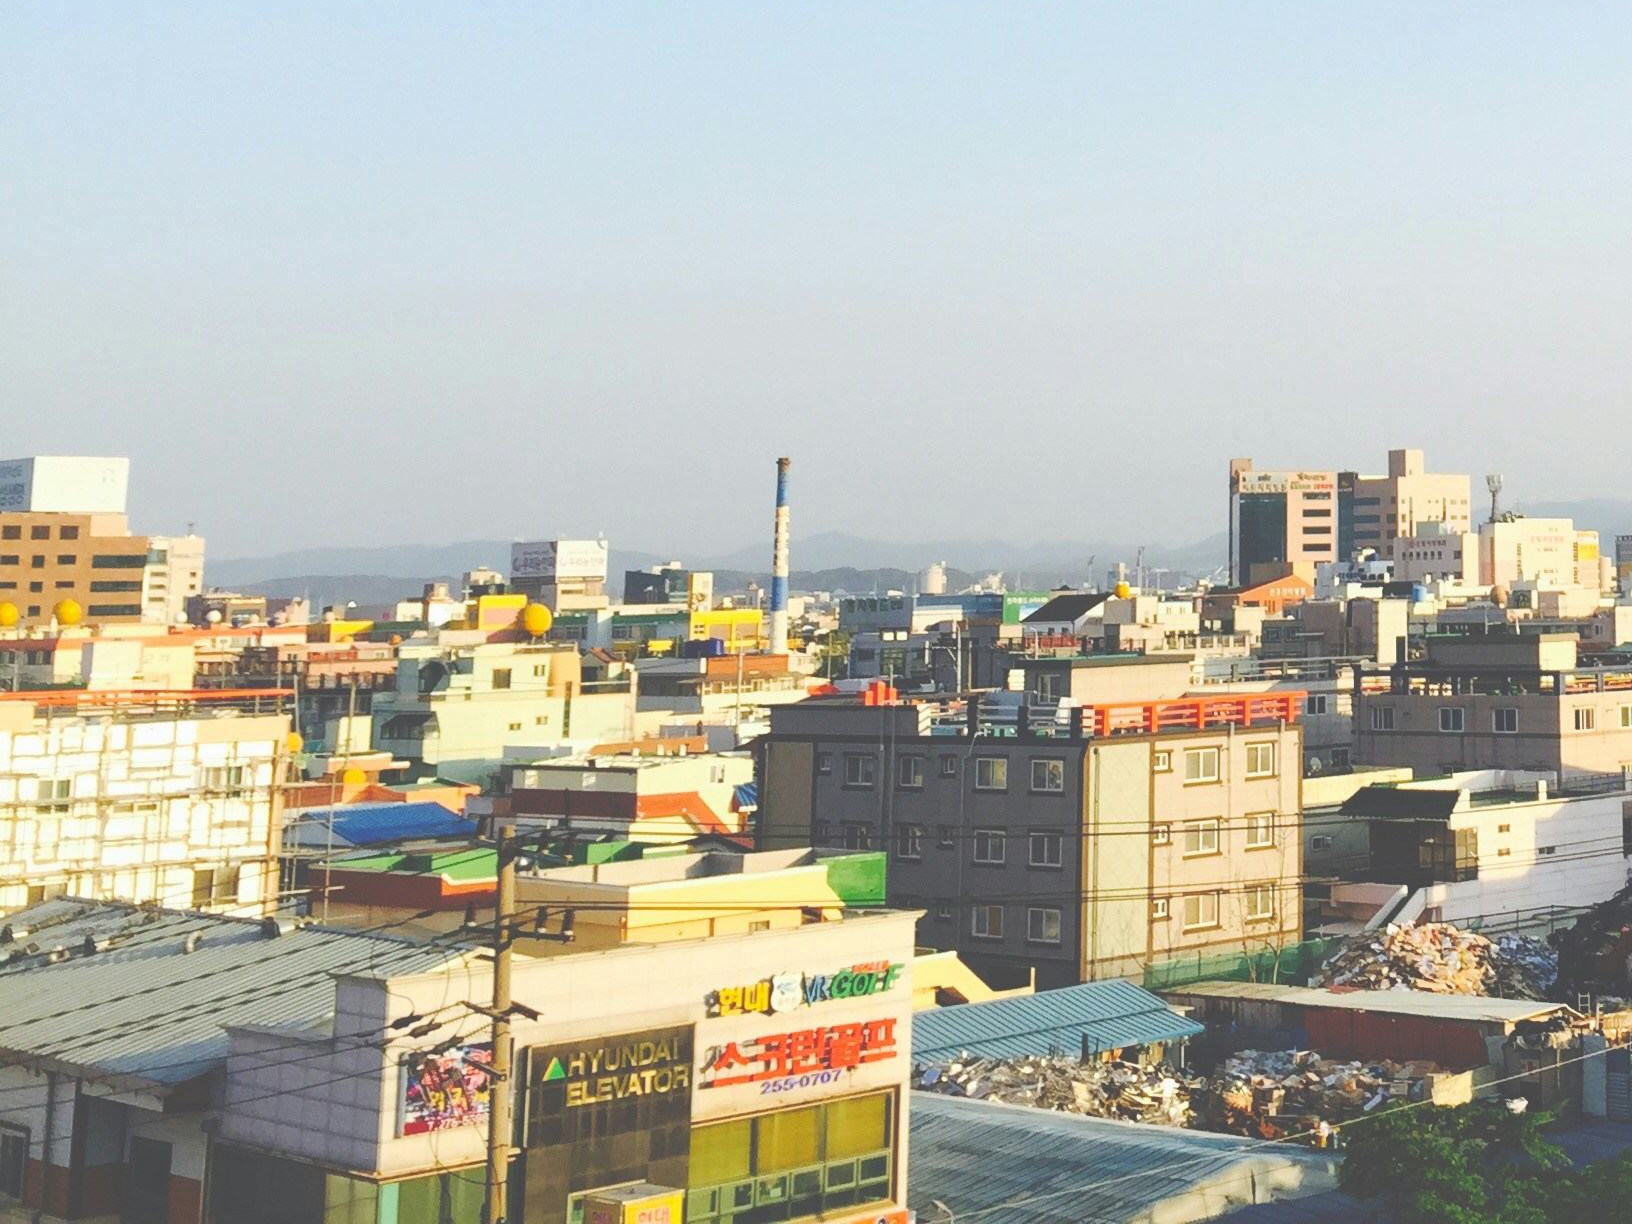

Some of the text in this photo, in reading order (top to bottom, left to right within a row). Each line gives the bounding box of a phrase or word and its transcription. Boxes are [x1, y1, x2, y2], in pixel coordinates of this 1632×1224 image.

[719, 981, 770, 1016] 현대
[830, 963, 905, 1000] GOLF
[567, 1036, 680, 1077] HYUNDAI
[712, 1018, 898, 1088] 스크린골프
[566, 1064, 690, 1107] ELEVATOR
[760, 1069, 842, 1096] 255-0707
